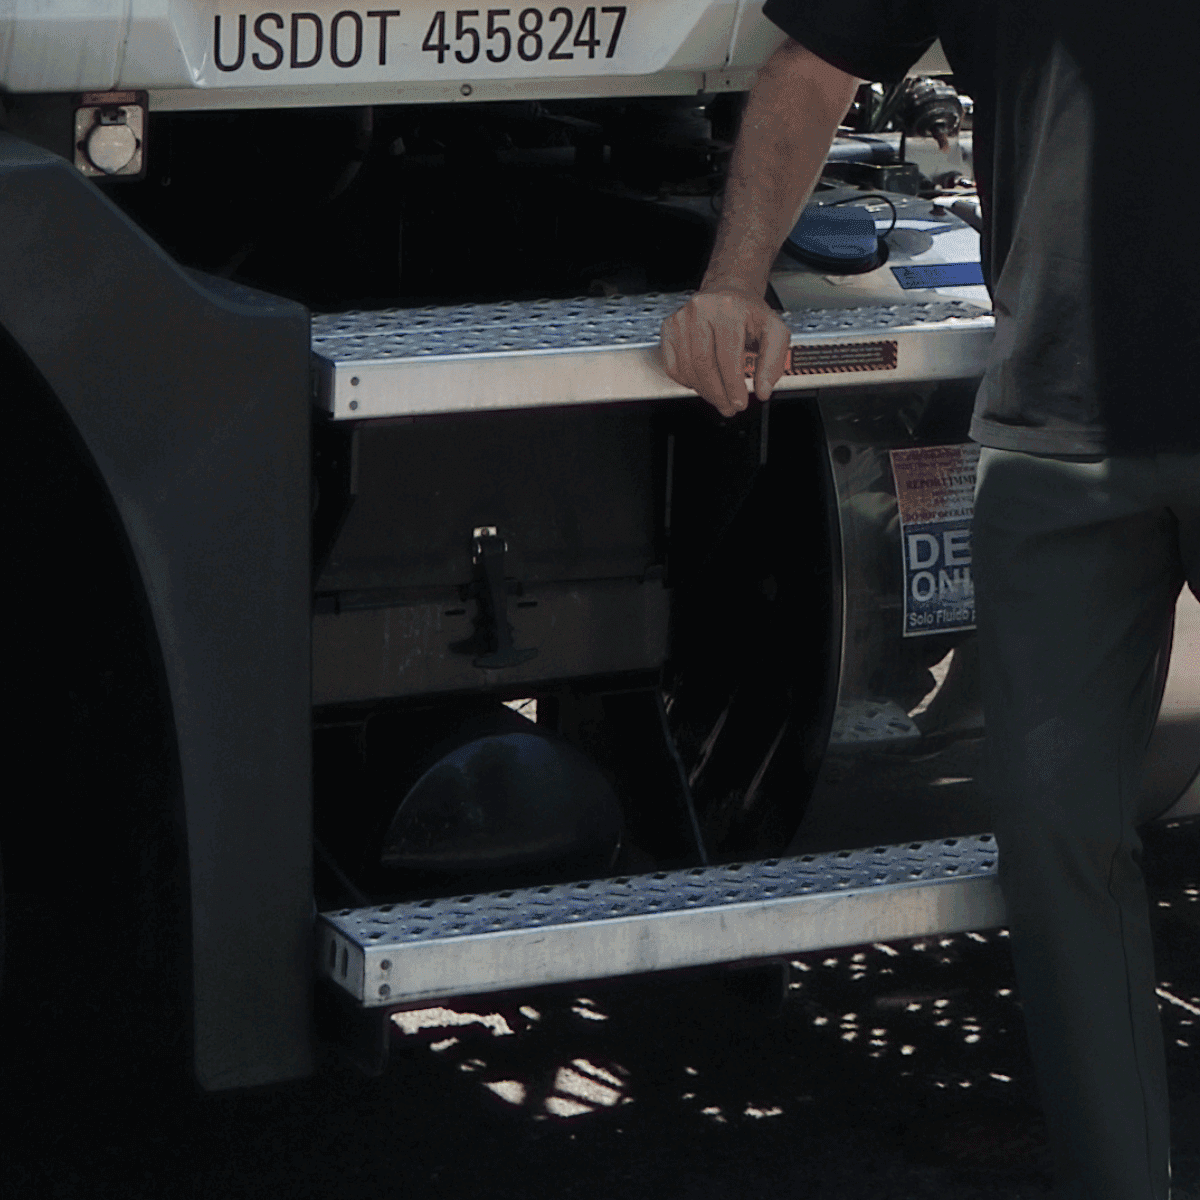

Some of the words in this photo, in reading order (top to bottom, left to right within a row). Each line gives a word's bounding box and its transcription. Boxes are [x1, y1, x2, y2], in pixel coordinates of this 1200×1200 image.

[213, 9, 401, 73] USDOT
[421, 5, 628, 65] 4558247
[908, 529, 973, 570] DE
[909, 611, 934, 626] Solo
